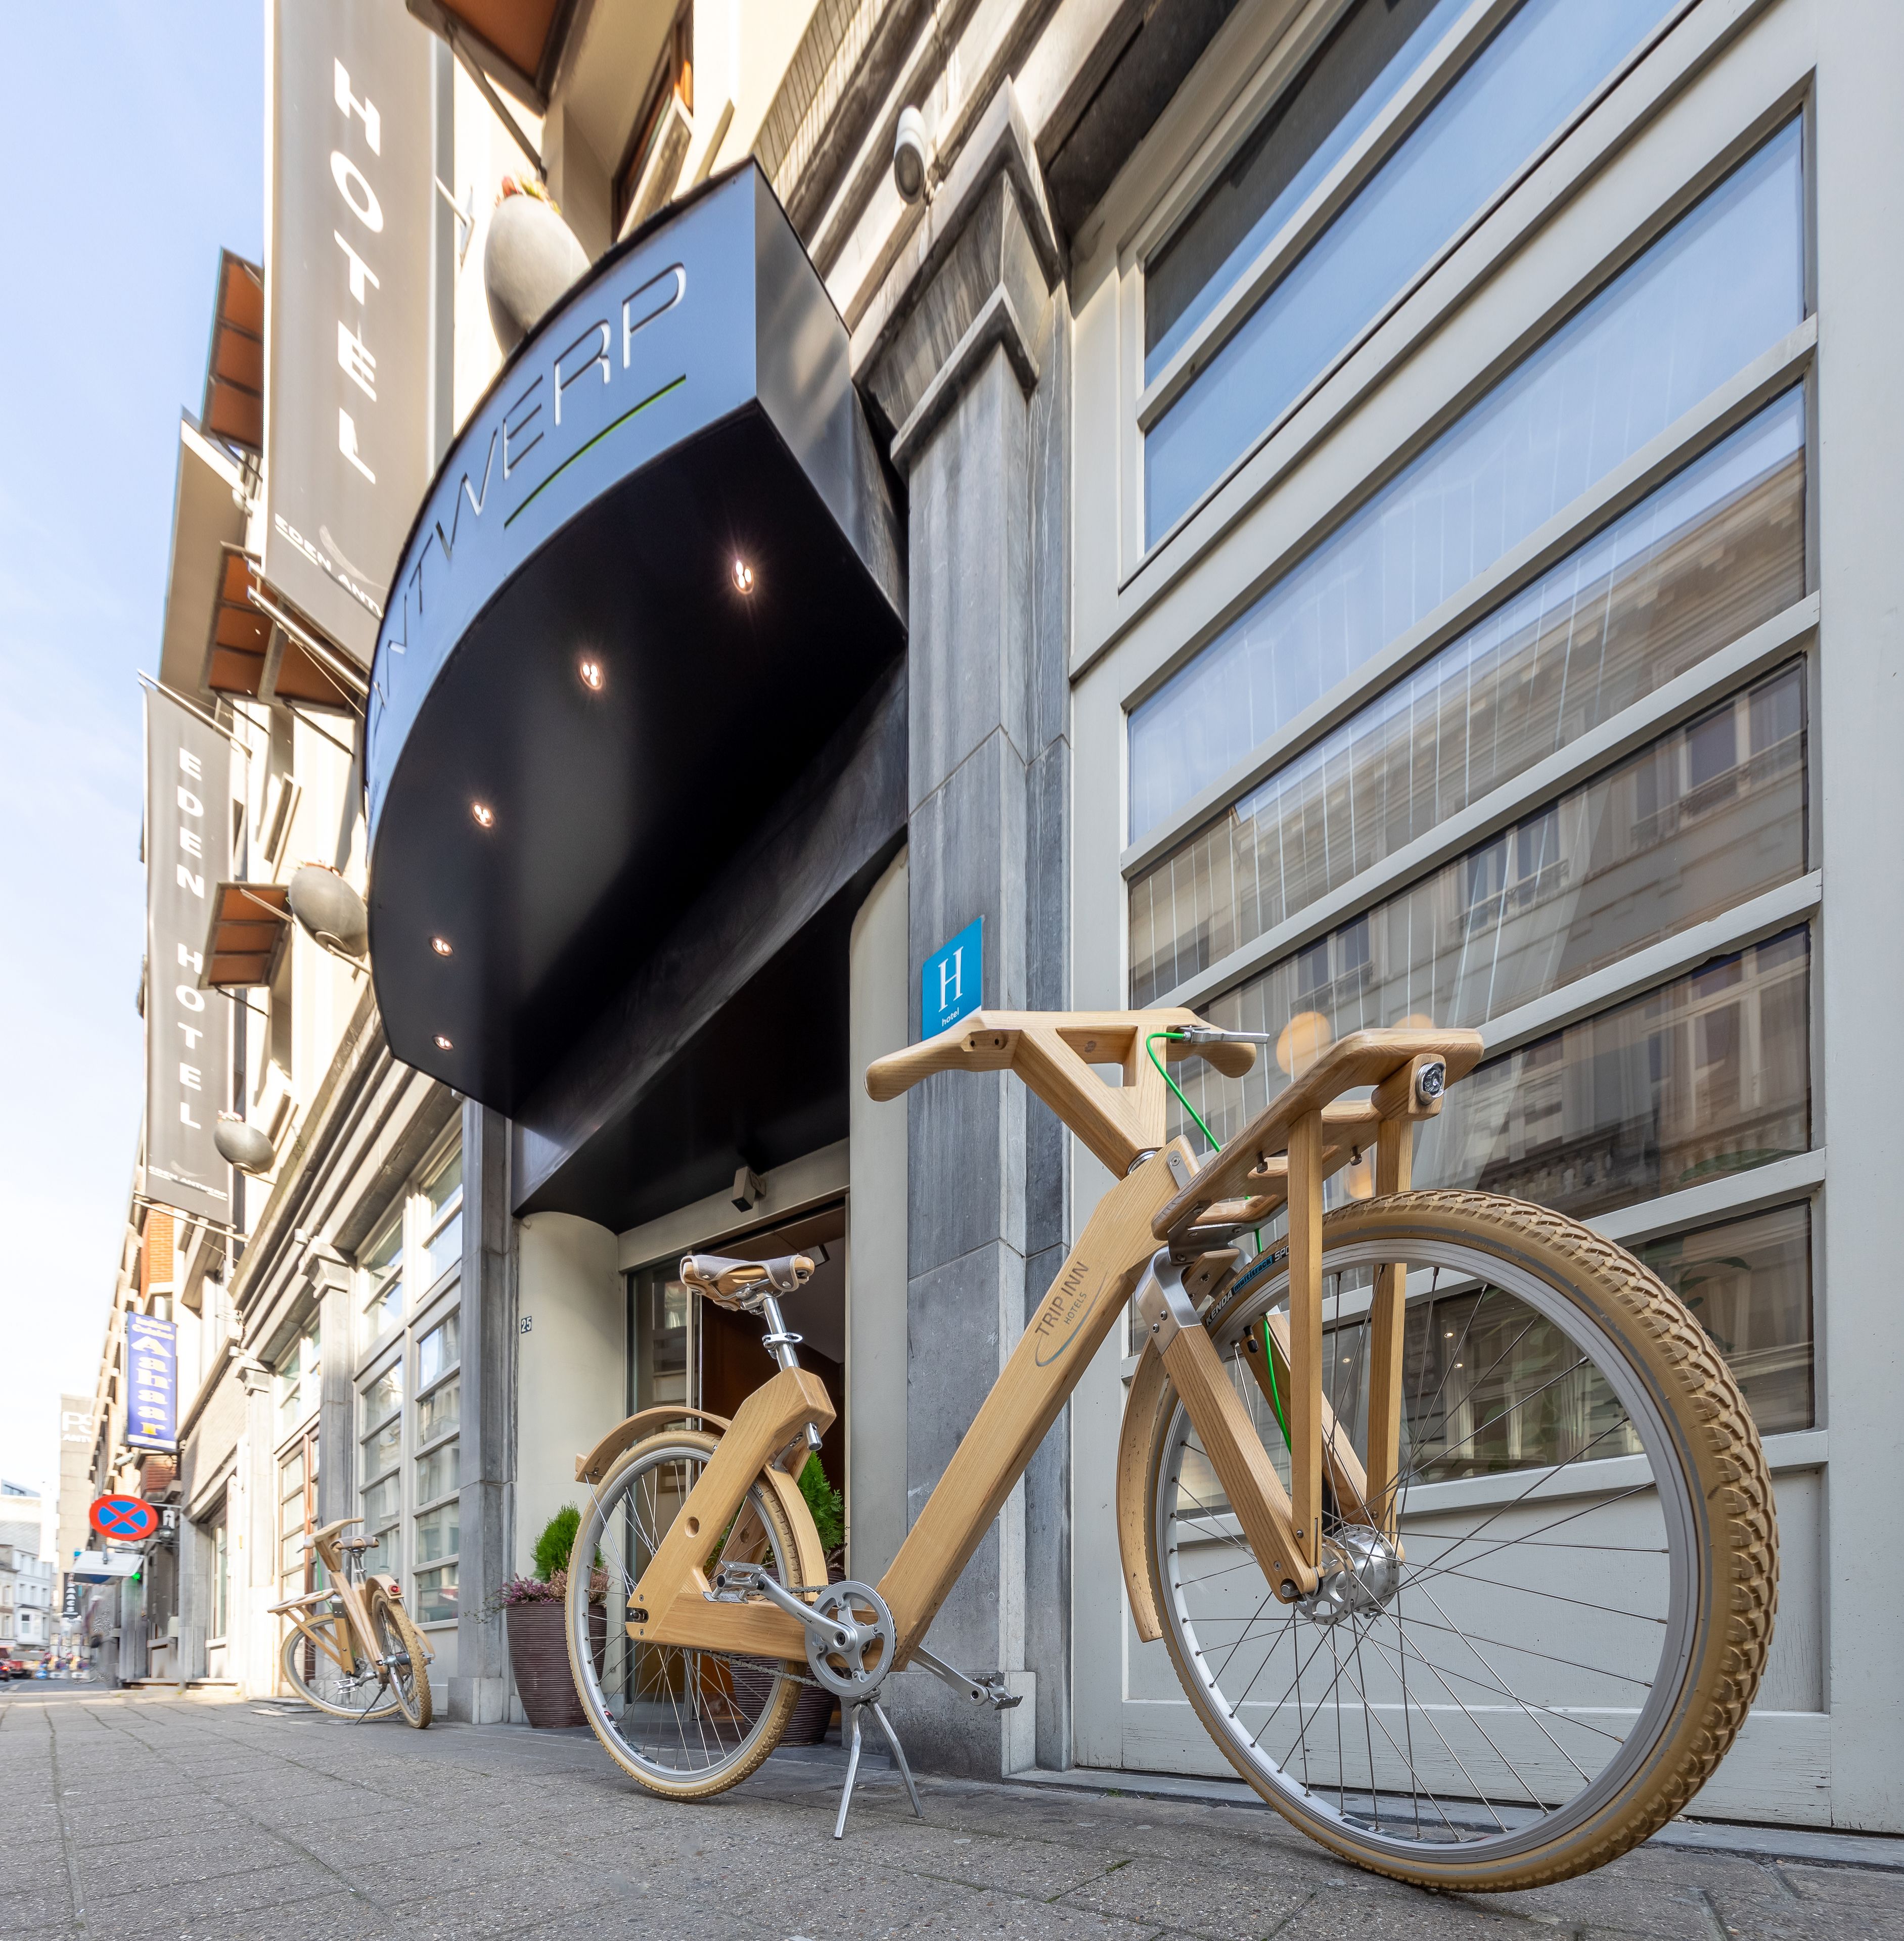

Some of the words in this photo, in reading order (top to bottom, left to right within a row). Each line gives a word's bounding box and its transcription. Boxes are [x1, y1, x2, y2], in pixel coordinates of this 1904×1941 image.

[330, 57, 383, 484] HOTEL
[275, 513, 331, 572] EDEN
[176, 747, 204, 899] EDEN
[938, 946, 964, 1012] H
[175, 943, 205, 1129] HOTEL
[942, 1007, 959, 1027] hotel
[521, 1317, 531, 1332] 25
[1035, 1296, 1064, 1335] TRIP
[1061, 1261, 1089, 1297] INN
[1064, 1292, 1087, 1325] HOTELS
[1205, 1289, 1233, 1326] KENDA
